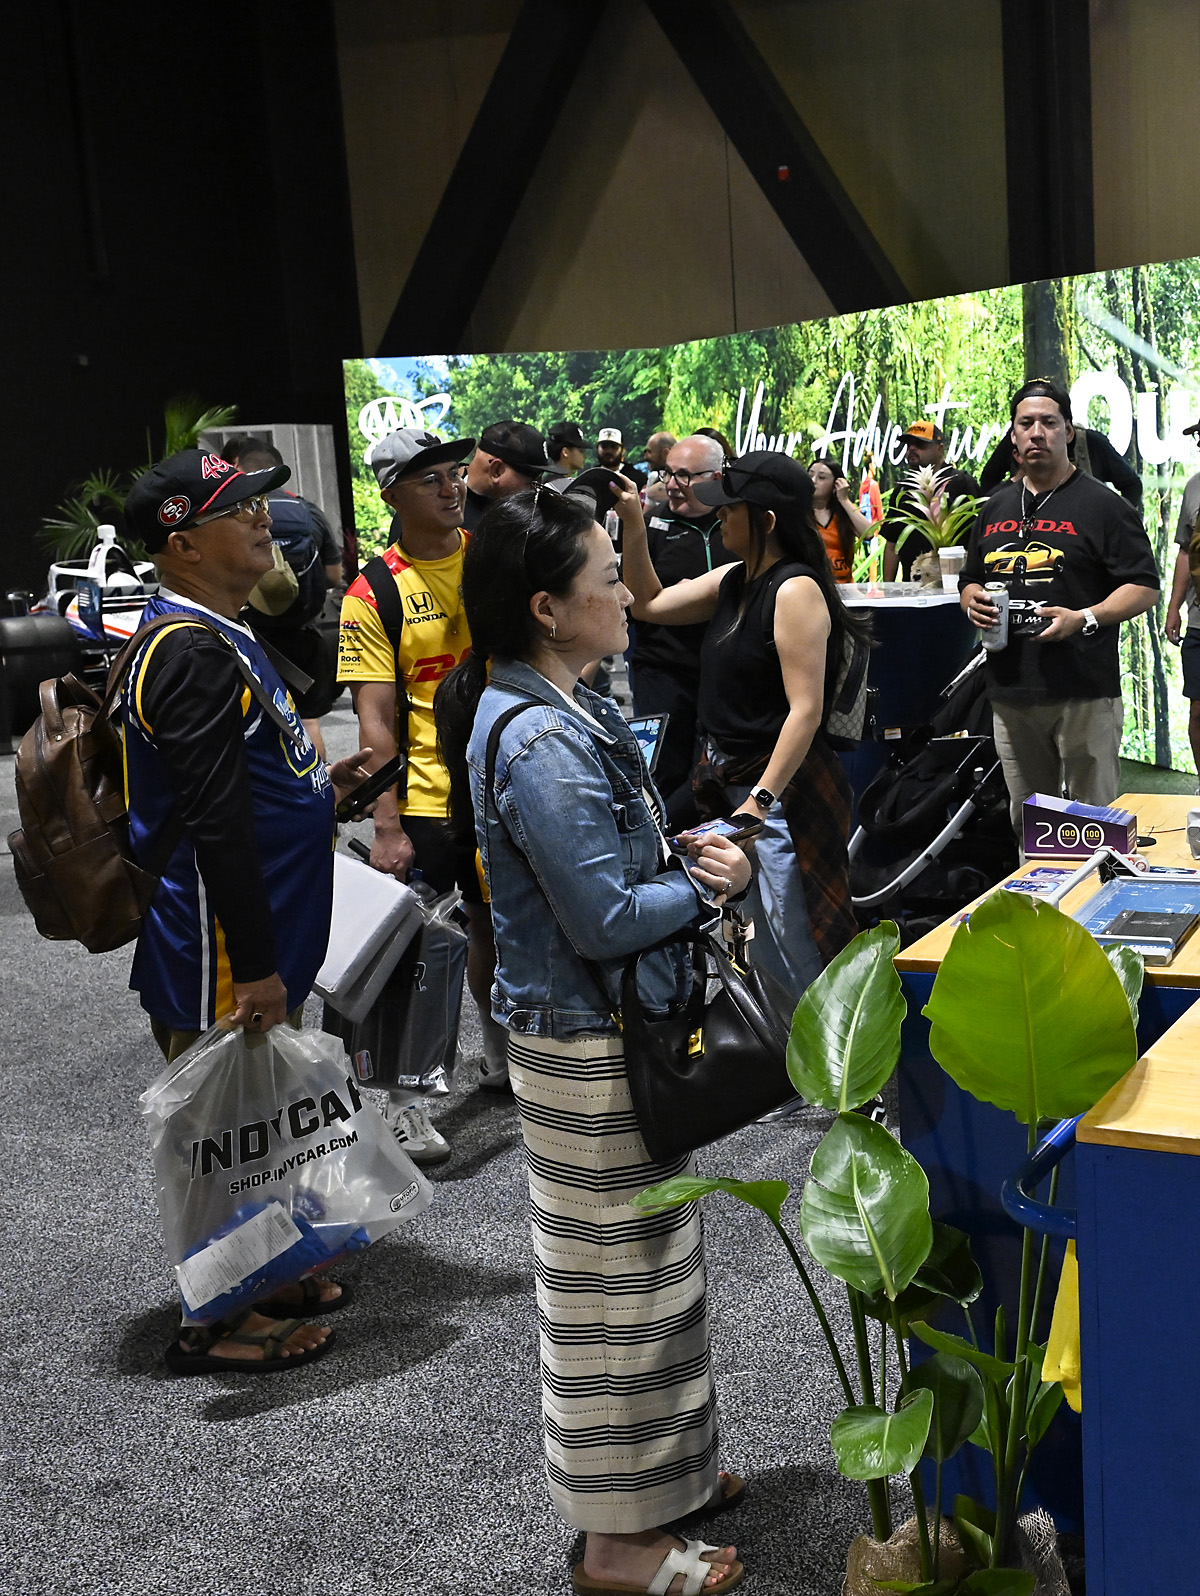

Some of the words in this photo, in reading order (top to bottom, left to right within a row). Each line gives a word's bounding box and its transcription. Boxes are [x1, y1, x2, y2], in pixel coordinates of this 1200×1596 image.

[735, 380, 802, 458] Your
[811, 371, 1012, 478] Advetur
[1008, 599, 1048, 610] SX
[406, 612, 448, 626] HONDA
[1035, 822, 1105, 849] 200
[1061, 829, 1076, 838] 100
[1085, 830, 1100, 839] 100
[228, 1130, 359, 1196] SHOP.INYCAR.COM
